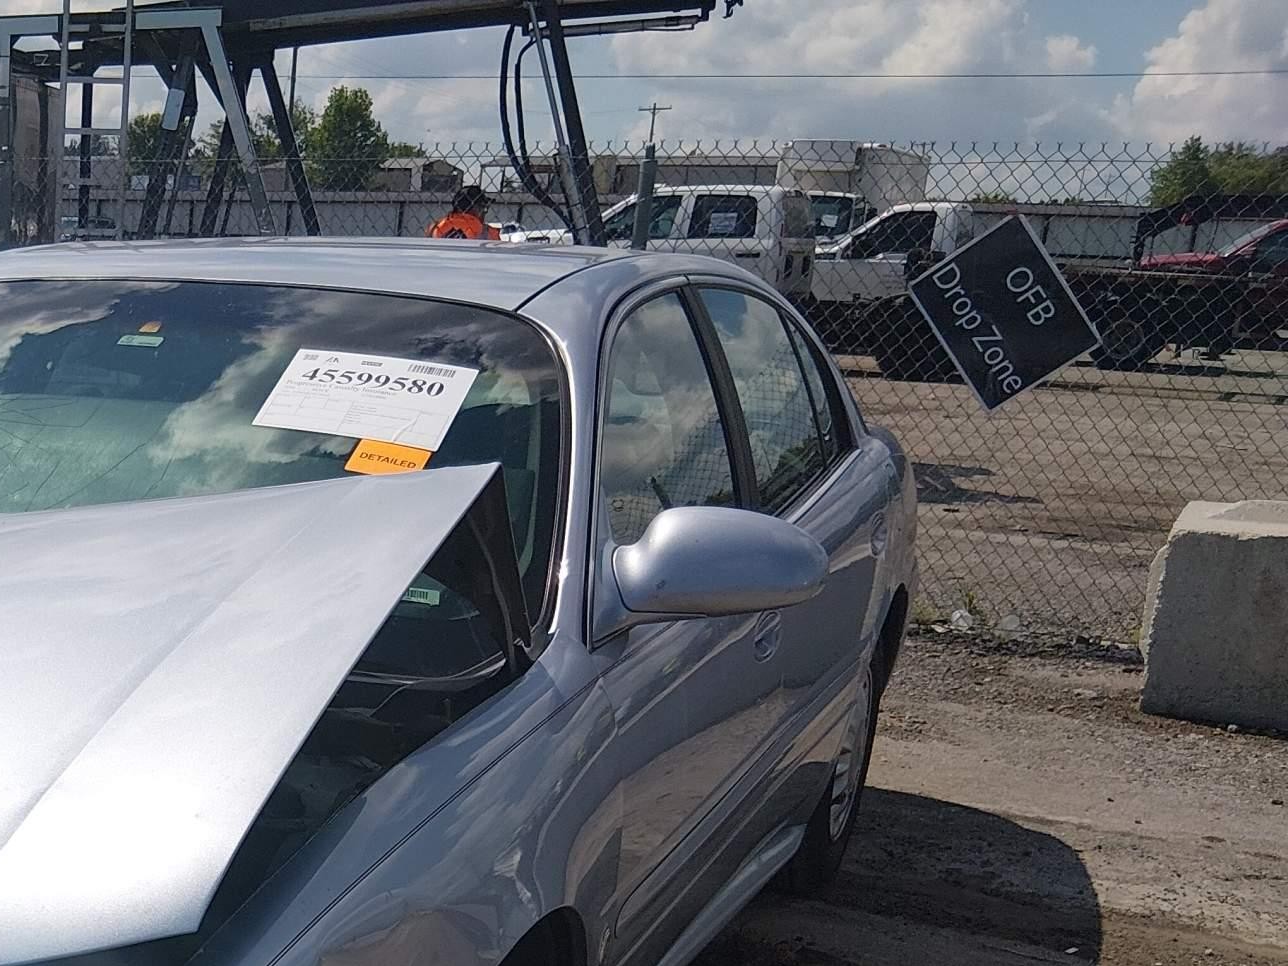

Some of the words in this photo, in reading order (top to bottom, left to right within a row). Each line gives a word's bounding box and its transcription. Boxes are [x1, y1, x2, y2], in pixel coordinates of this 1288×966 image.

[1006, 267, 1055, 325] OFB
[932, 262, 982, 330] Drop
[972, 324, 1023, 393] Zone
[301, 367, 445, 397] 45599580
[359, 452, 417, 469] DETAILED
